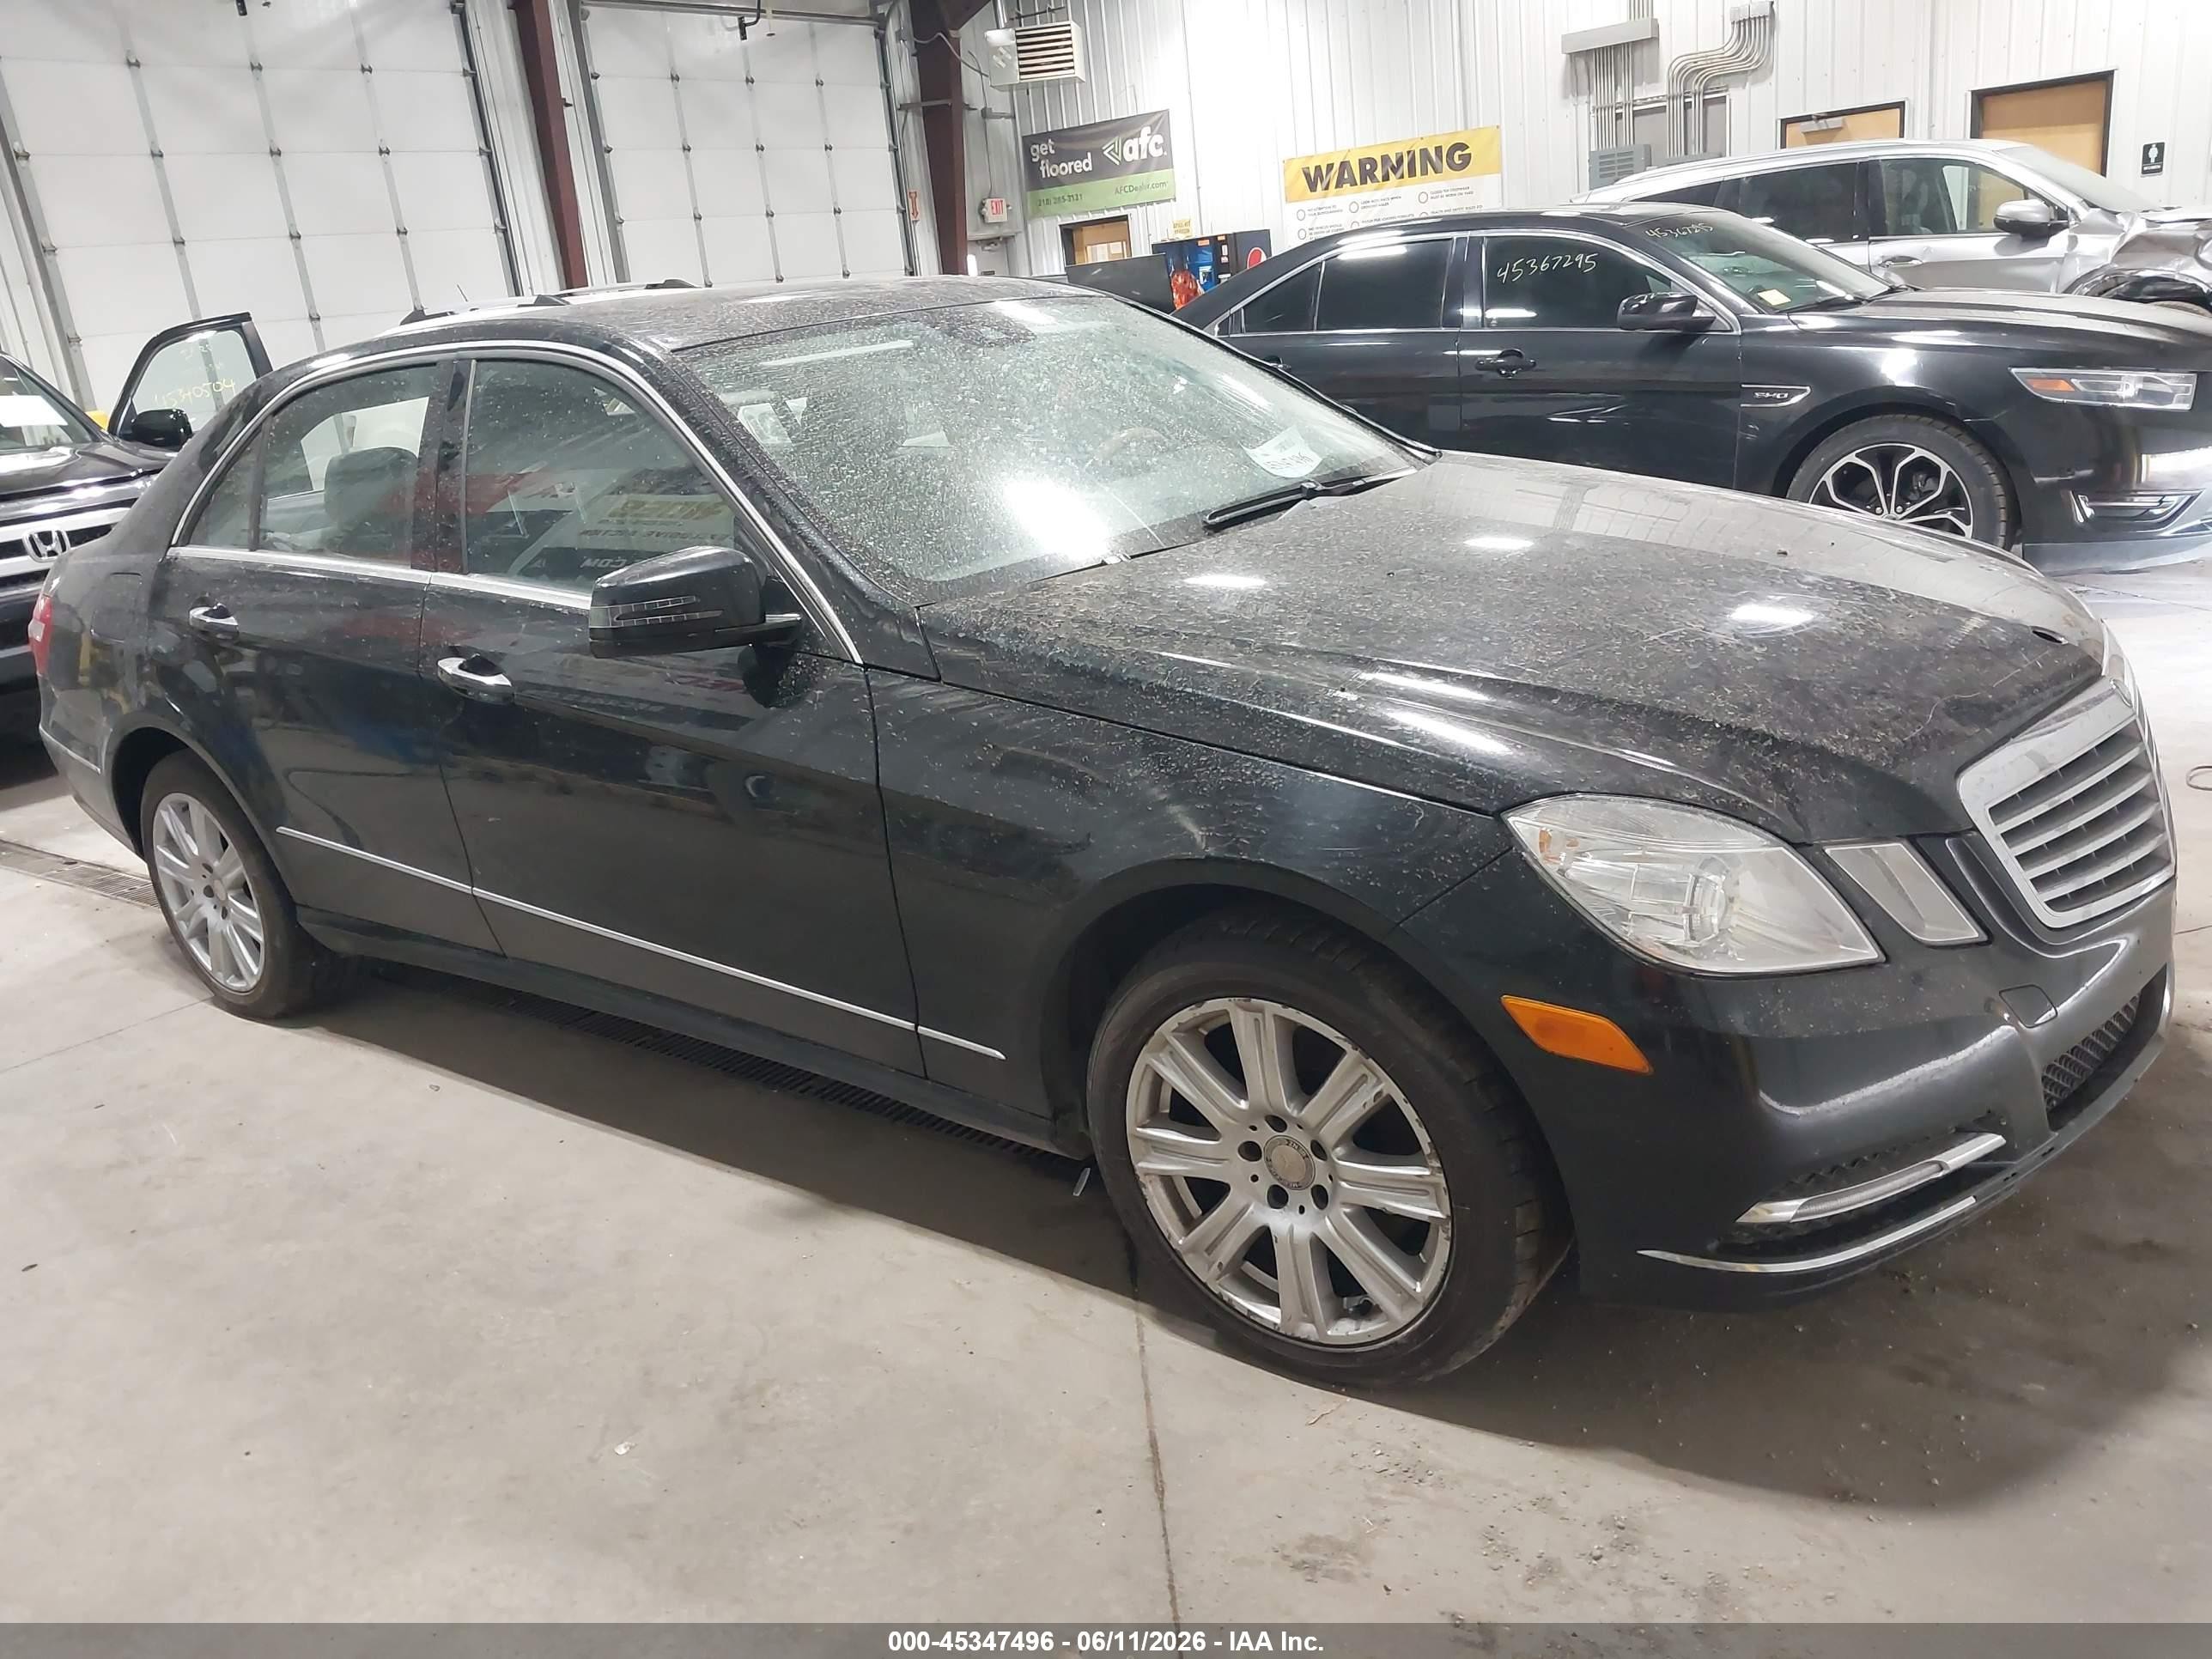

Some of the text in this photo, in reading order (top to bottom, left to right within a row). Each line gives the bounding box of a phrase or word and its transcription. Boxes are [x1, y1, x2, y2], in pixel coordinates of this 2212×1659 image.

[1030, 138, 1054, 162] get
[1040, 152, 1092, 179] floored
[1302, 143, 1472, 193] WARNING
[991, 199, 1003, 215] EXIT
[1497, 253, 1599, 284] 45367295
